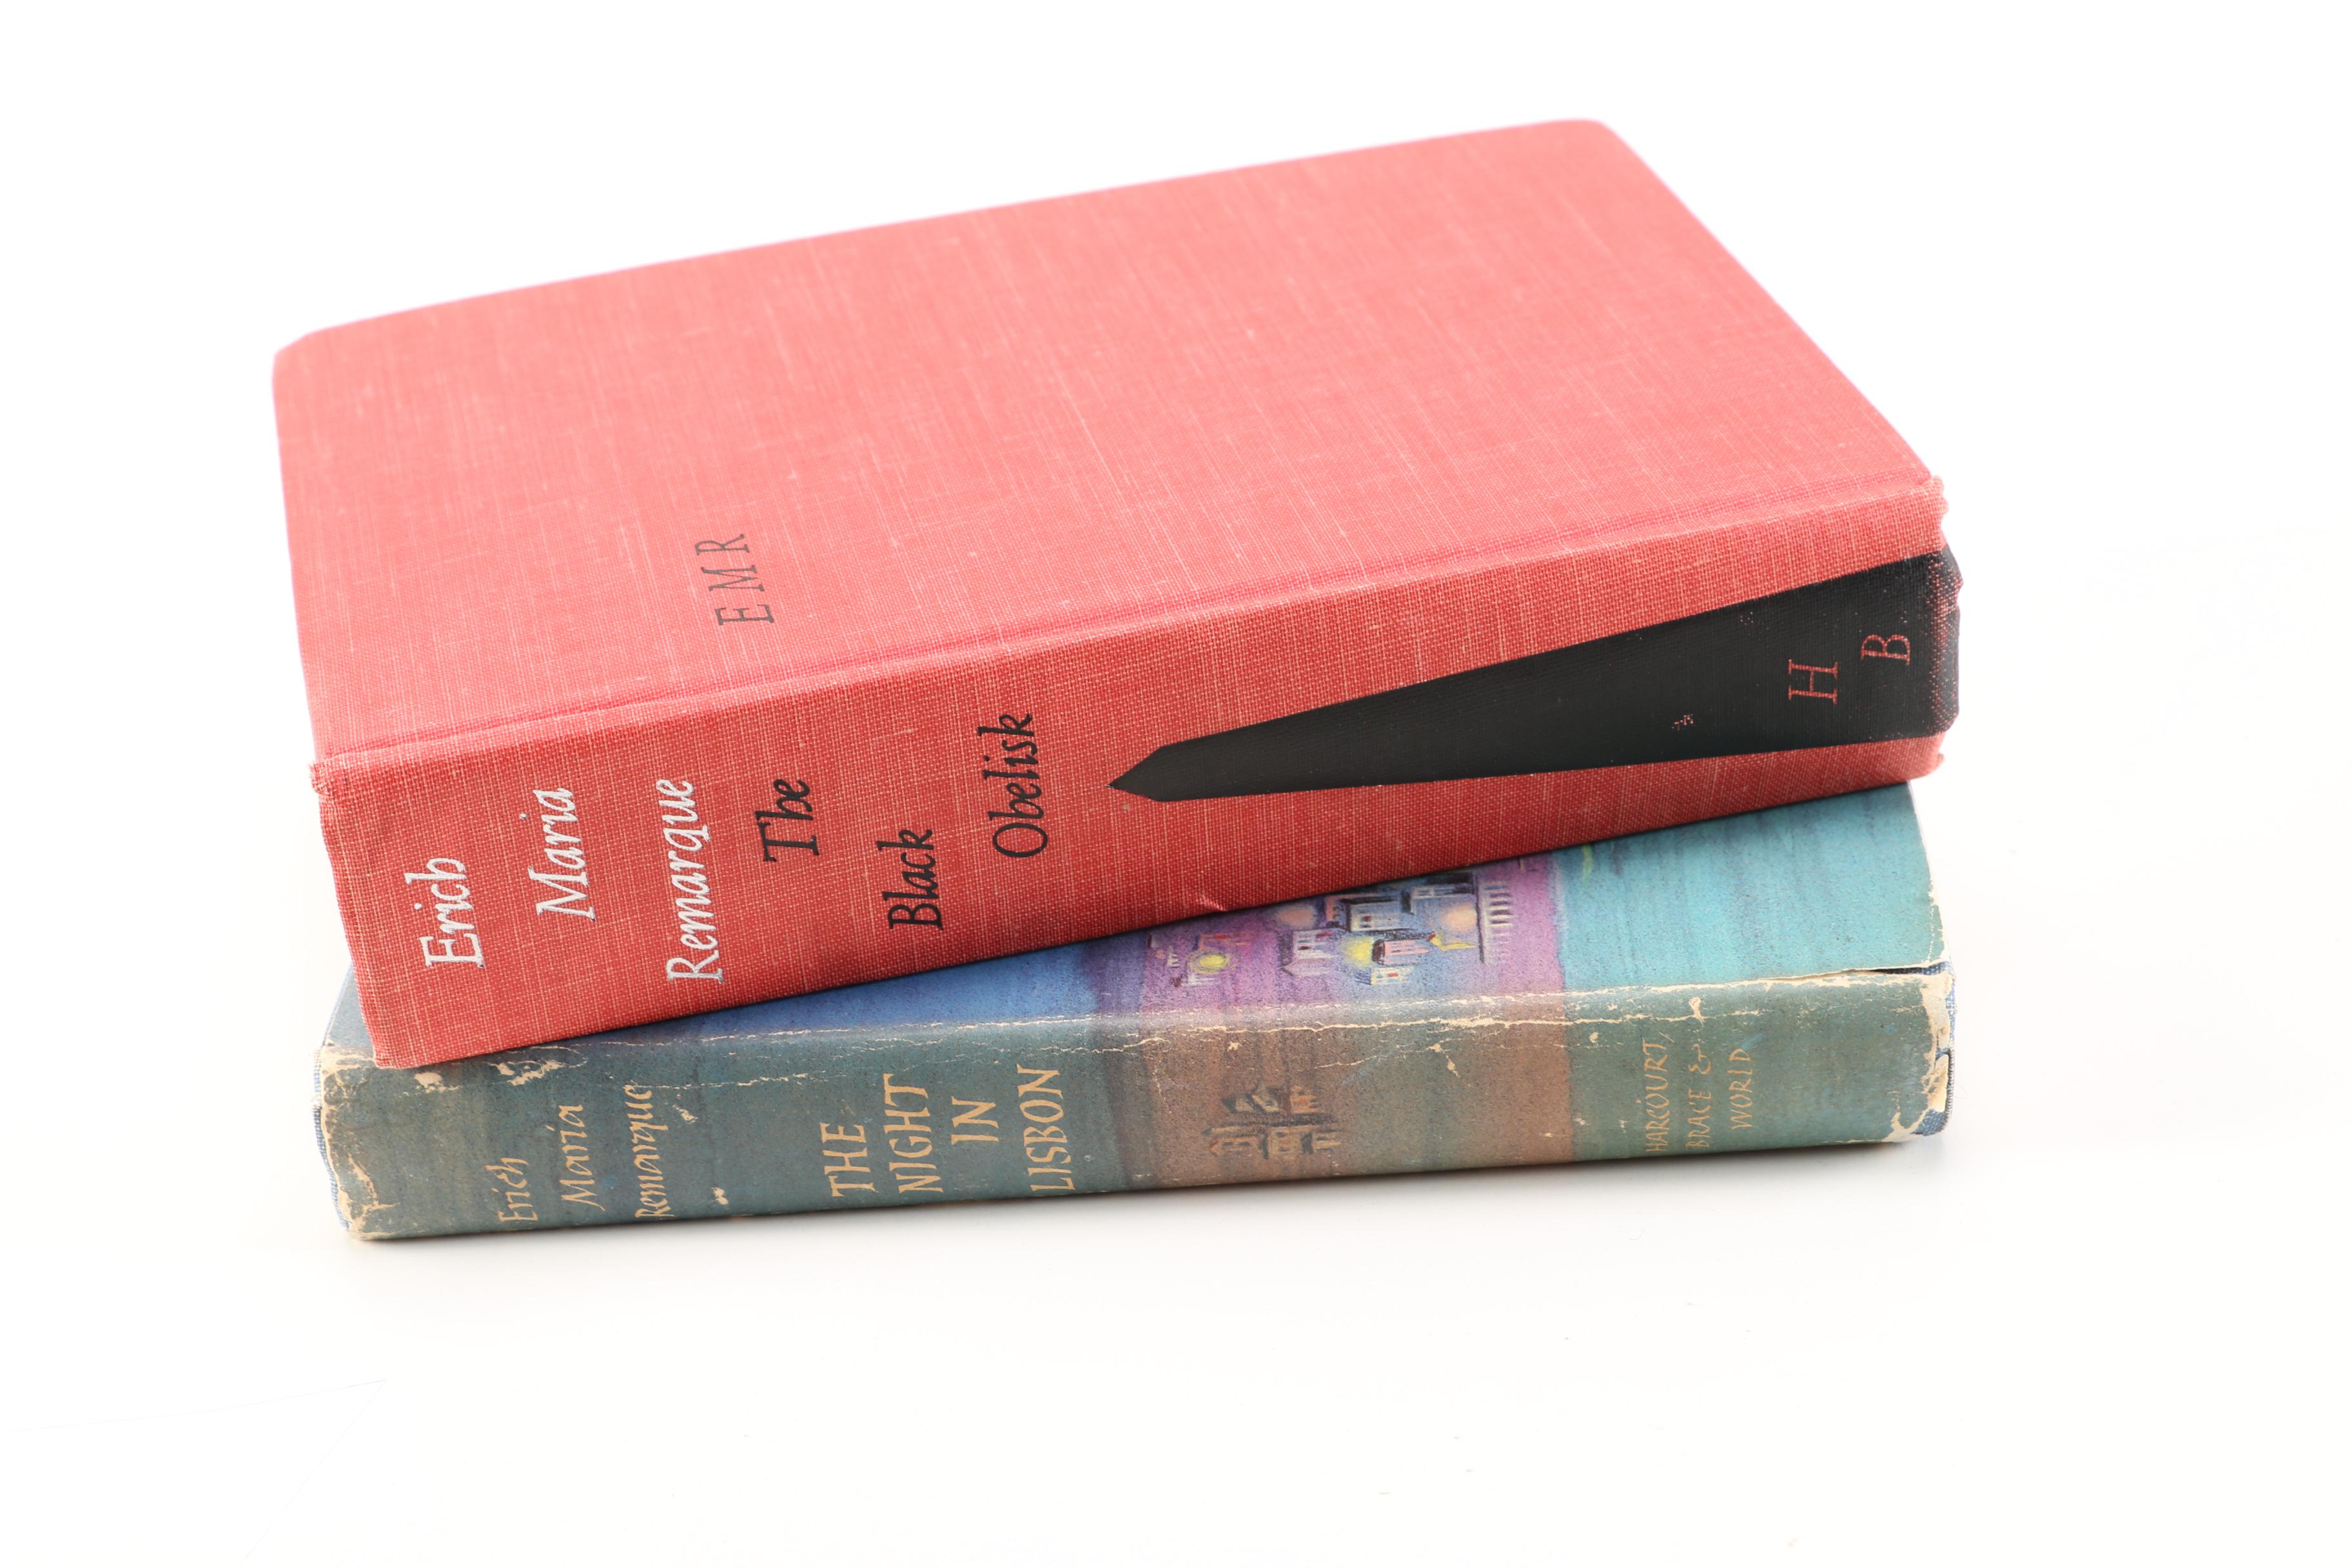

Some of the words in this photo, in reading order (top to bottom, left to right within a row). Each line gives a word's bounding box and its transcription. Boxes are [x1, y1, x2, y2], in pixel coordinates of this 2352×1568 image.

[1788, 659, 1838, 705] H
[1861, 633, 1911, 665] B
[754, 778, 820, 862] The
[977, 712, 1048, 858] Obelisk
[520, 787, 596, 921] Maria
[655, 778, 724, 984] Remarque
[877, 828, 943, 930] Black
[404, 857, 485, 968] Erich
[1687, 1043, 1712, 1075] &
[1727, 1048, 1754, 1130] WORLD
[545, 1104, 606, 1212] Maria
[623, 1083, 676, 1219] Remarque
[820, 1122, 879, 1197] THE
[883, 1073, 943, 1193] NIGHT
[951, 1096, 1000, 1144] IN
[1017, 1063, 1075, 1191] LISBON
[1685, 1088, 1712, 1148] BRACE
[485, 1157, 538, 1222] Erich
